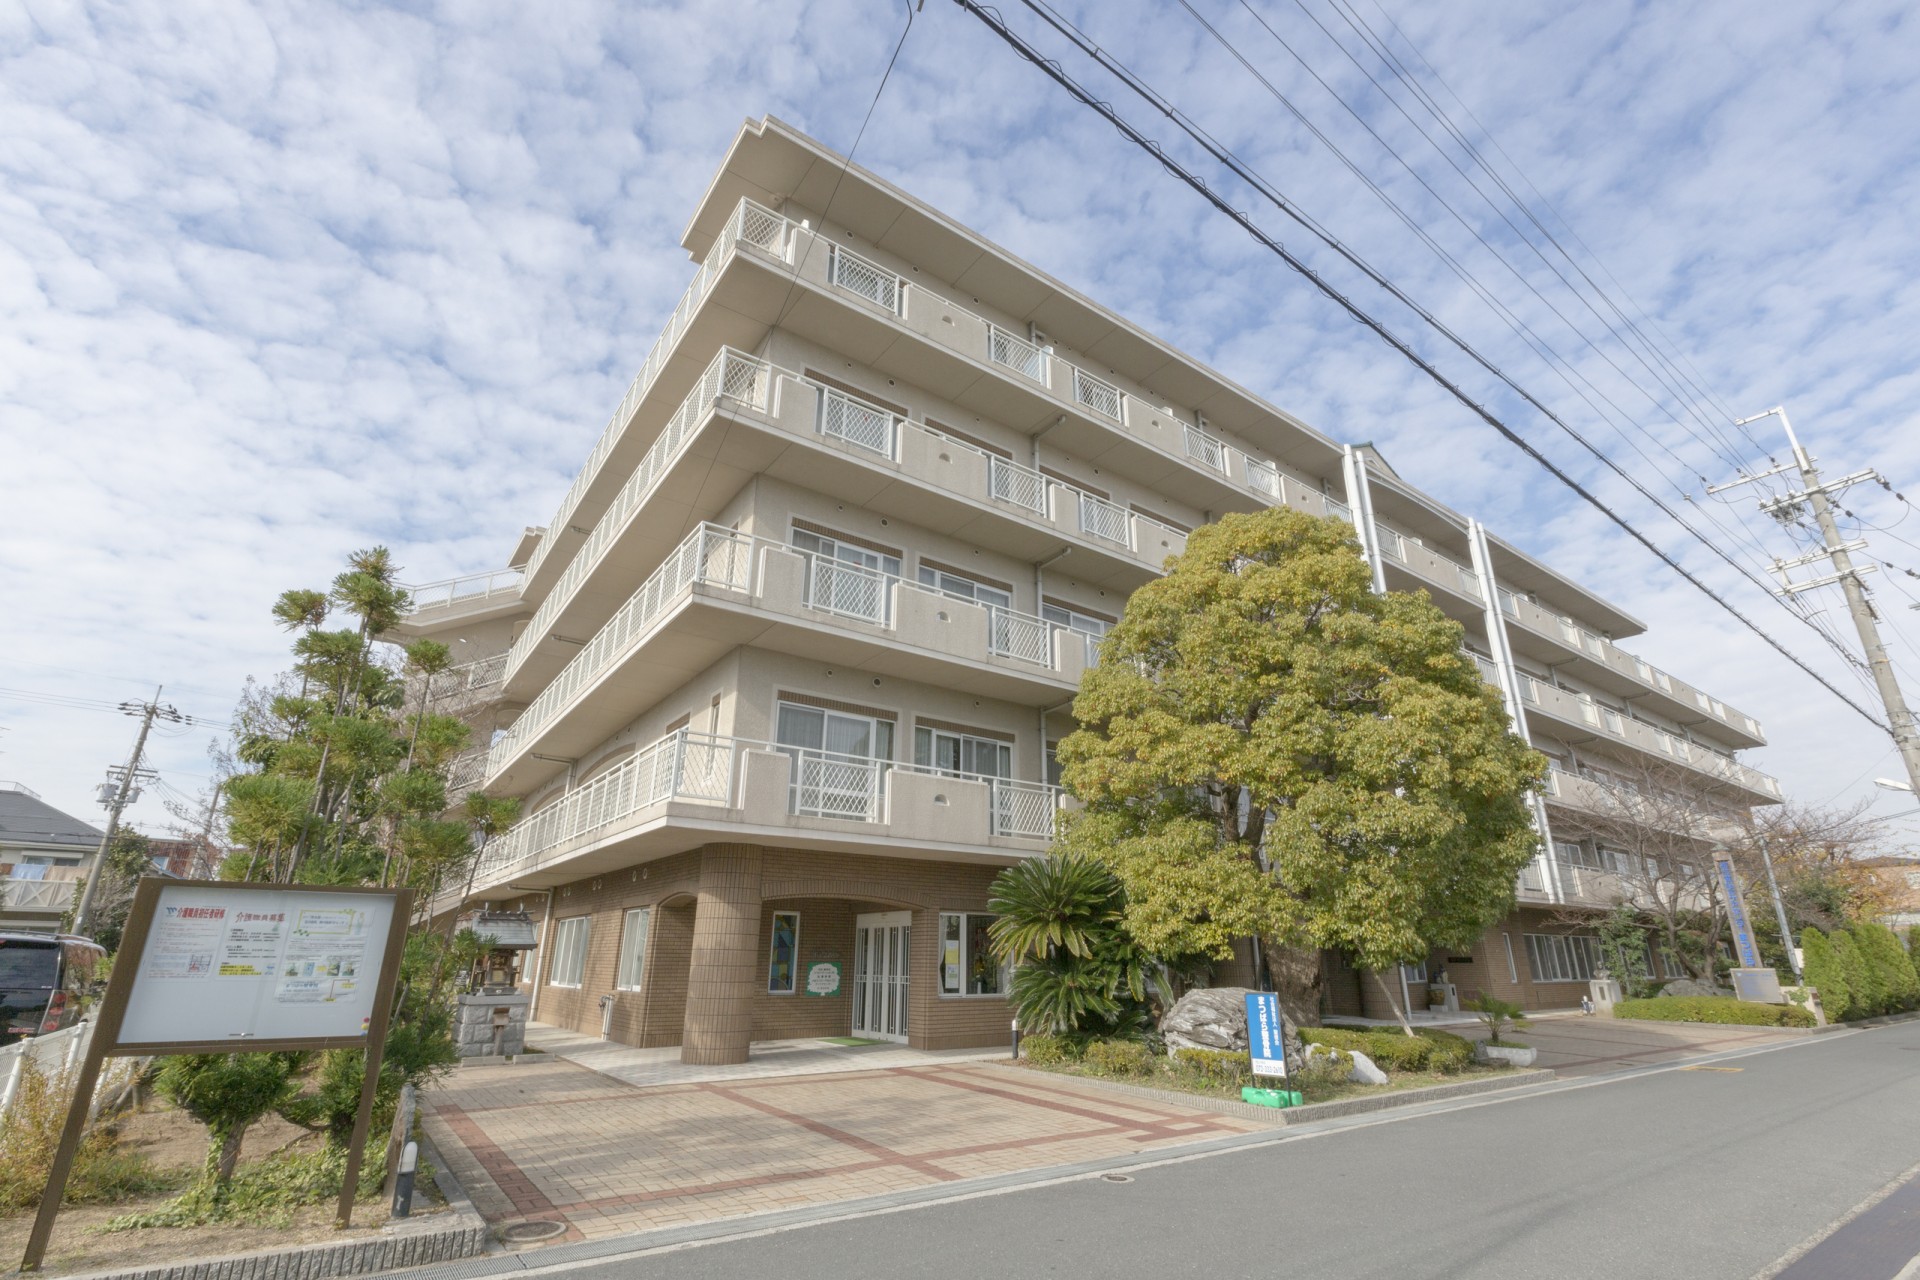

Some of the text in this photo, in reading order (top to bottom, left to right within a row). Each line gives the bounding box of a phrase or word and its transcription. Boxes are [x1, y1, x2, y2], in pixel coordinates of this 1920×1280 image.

[235, 911, 286, 923] 介護職員募集
